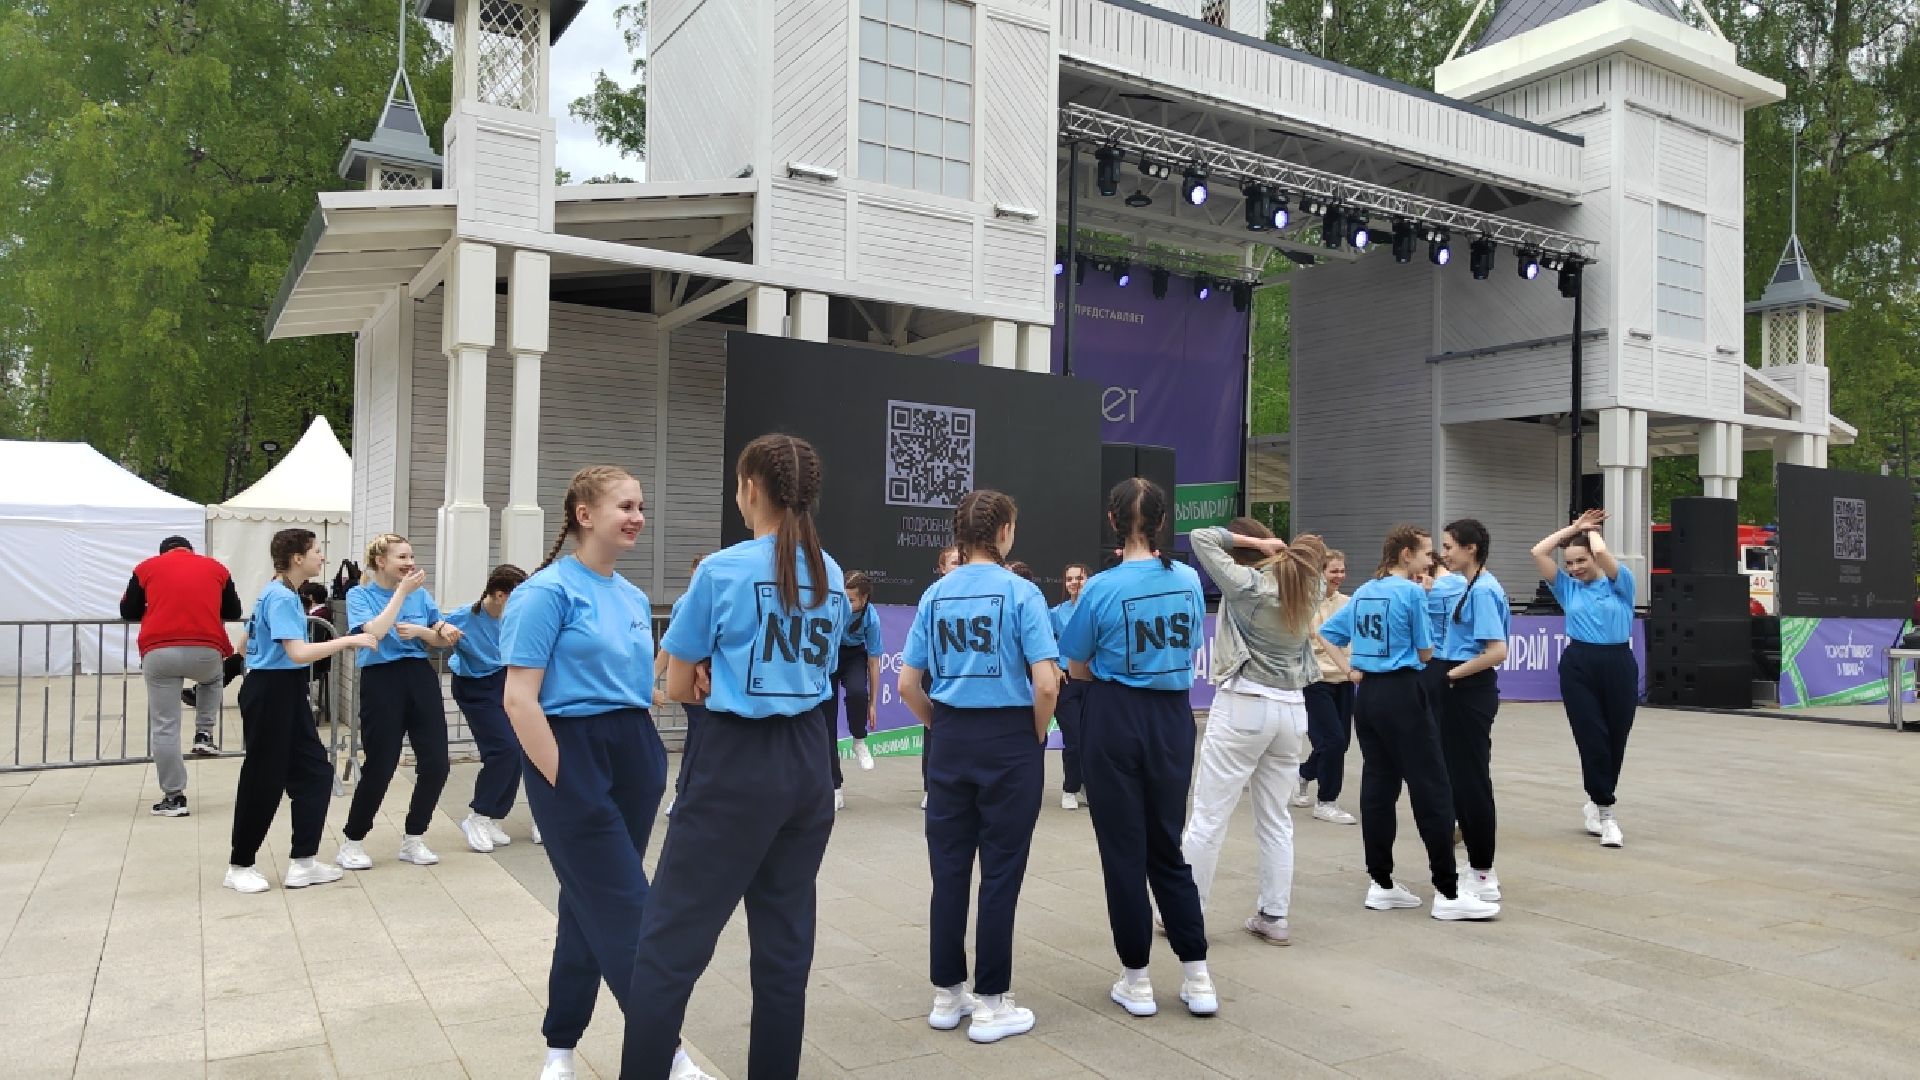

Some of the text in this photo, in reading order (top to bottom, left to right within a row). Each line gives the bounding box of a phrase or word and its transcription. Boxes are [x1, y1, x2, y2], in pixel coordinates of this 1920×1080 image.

[1074, 304, 1145, 324] ПРЕДСТАВЛЯЕТ
[897, 532, 955, 547] ИНФОРМАЦИ
[762, 612, 832, 668] NS
[937, 615, 993, 656] NS
[1135, 612, 1191, 654] NS
